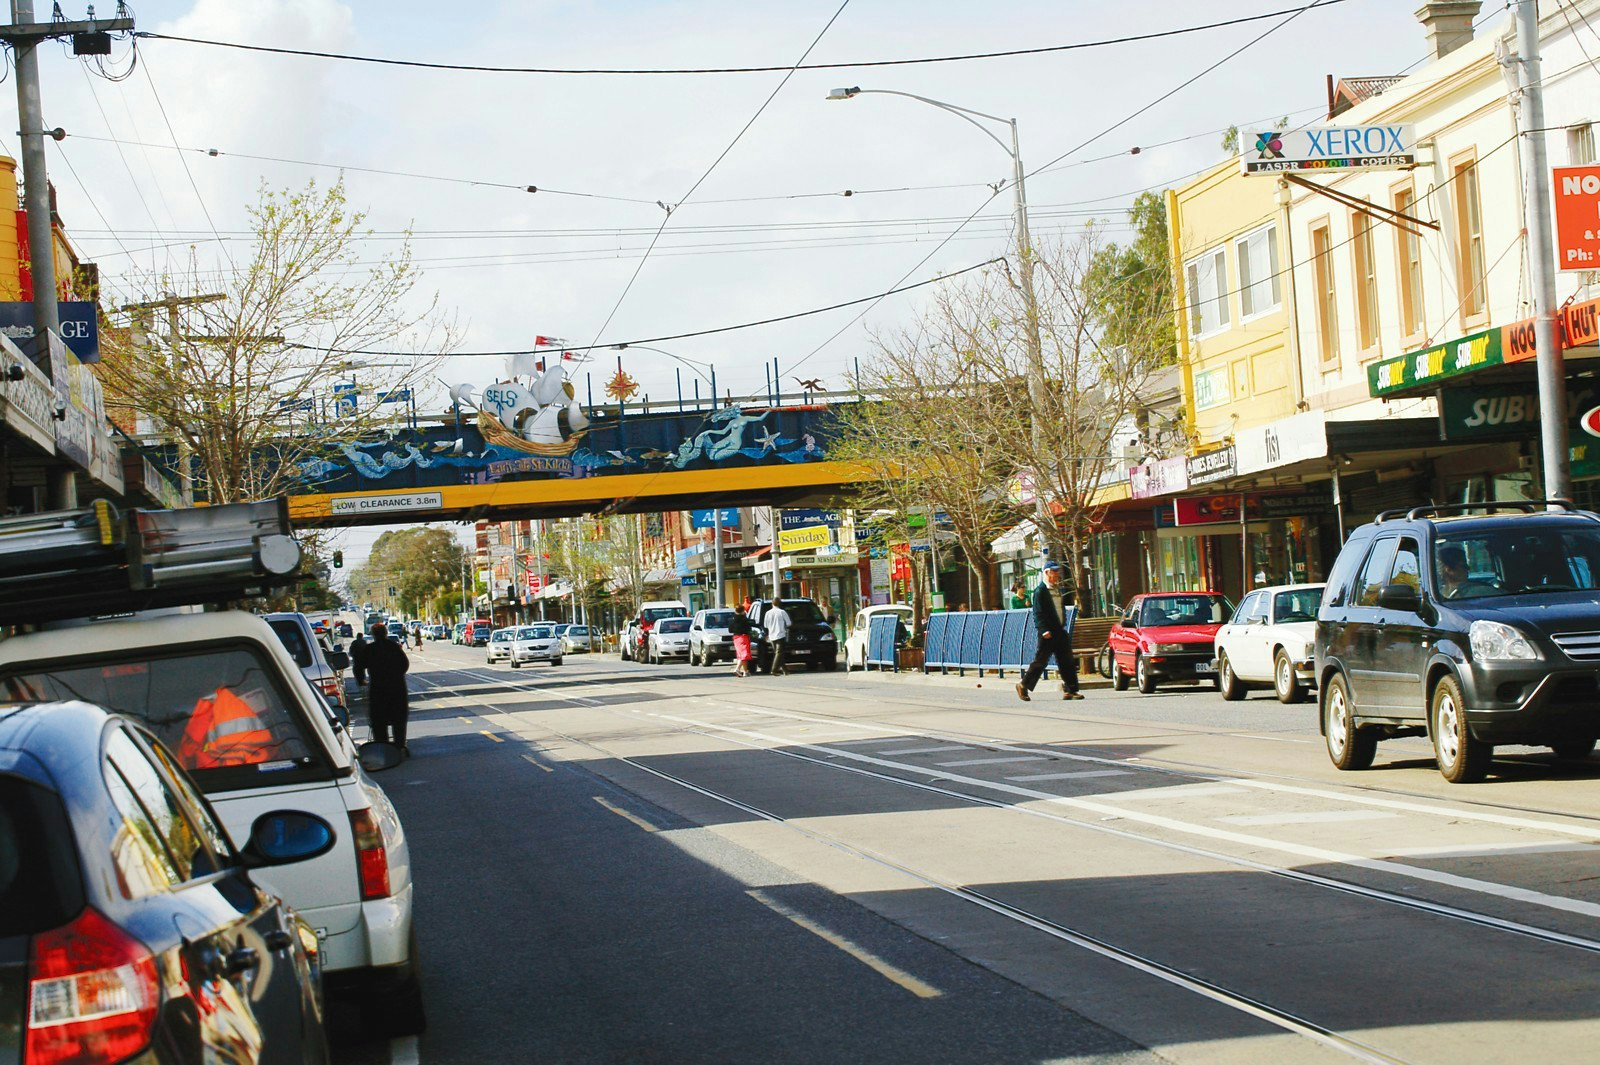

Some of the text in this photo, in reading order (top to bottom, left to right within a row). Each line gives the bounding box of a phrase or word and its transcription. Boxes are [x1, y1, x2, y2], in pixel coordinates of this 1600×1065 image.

[1306, 126, 1405, 157] XEROX
[1256, 157, 1407, 172] LASER COLOUR COPIES
[1567, 247, 1593, 262] Ph:
[1570, 303, 1597, 340] HUT
[1456, 333, 1490, 370] SUBWAY
[1377, 359, 1406, 390] SUBWAY
[1415, 346, 1447, 381] SUBWAY
[336, 497, 437, 510] LOW CLEARANCE 3.8m
[783, 516, 801, 524] THE
[781, 531, 827, 546] Sunday
